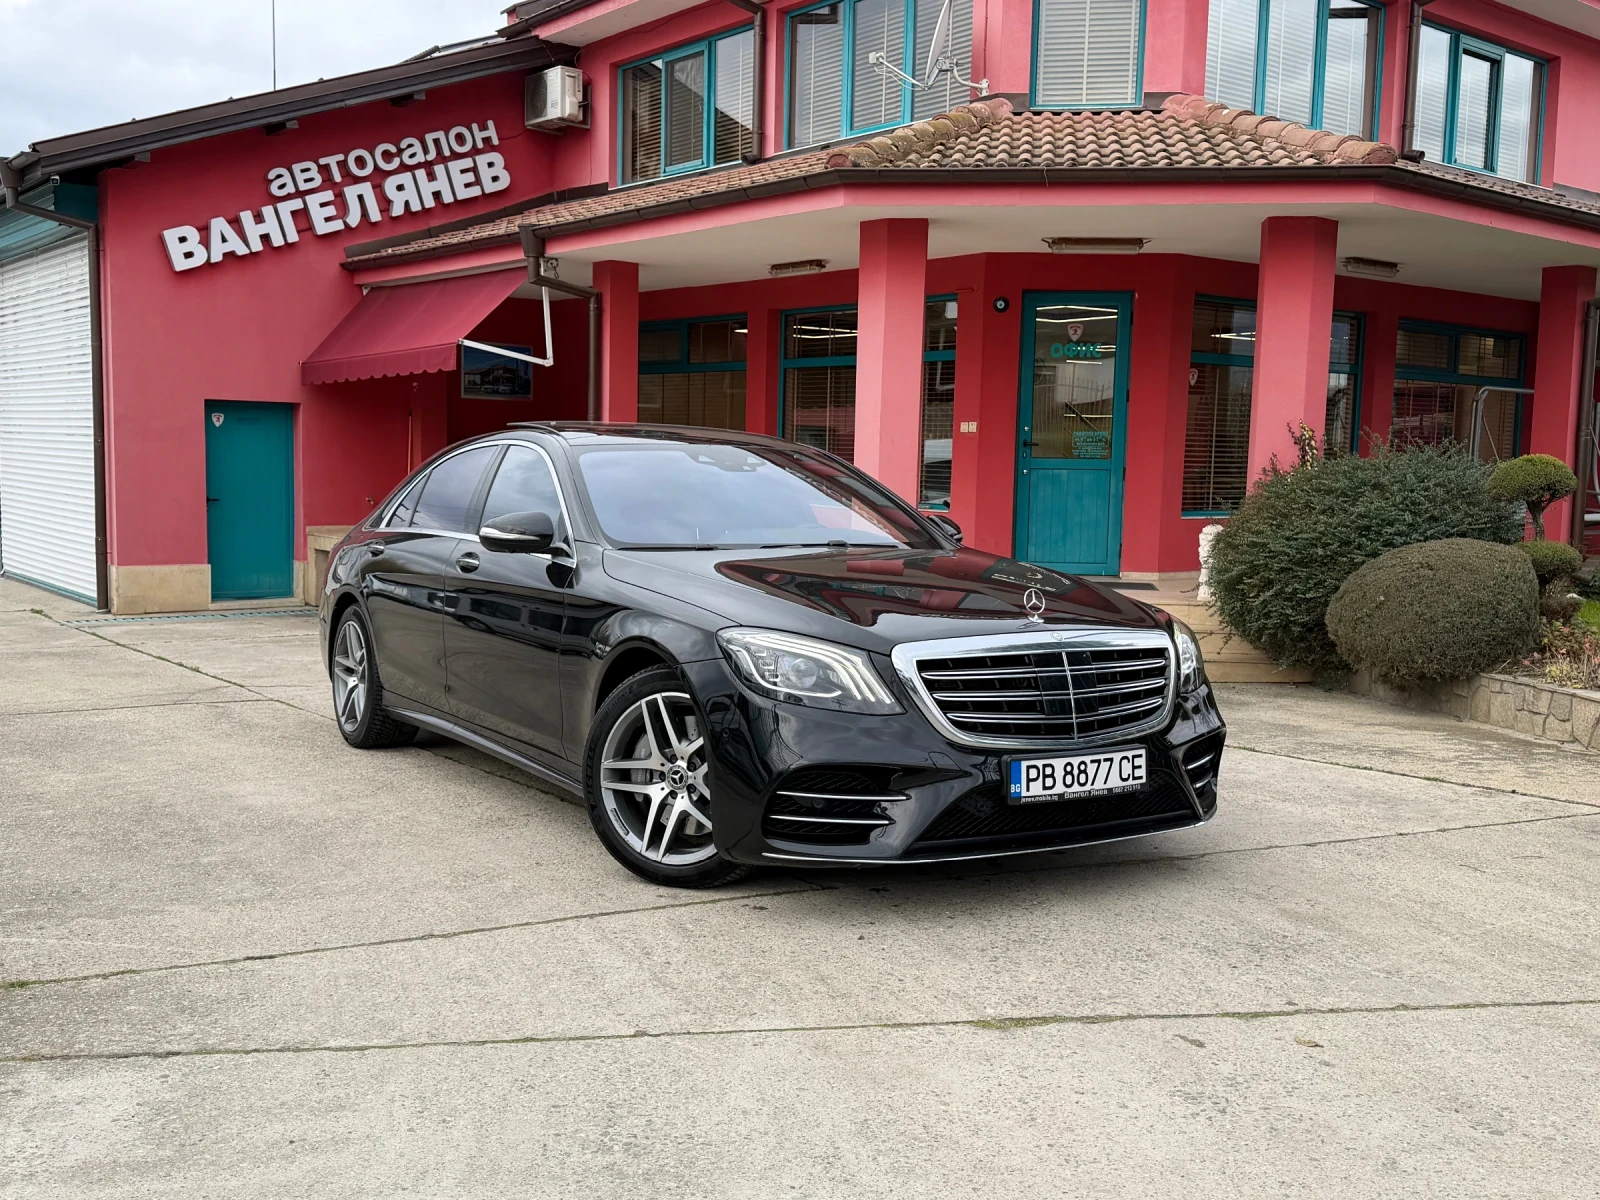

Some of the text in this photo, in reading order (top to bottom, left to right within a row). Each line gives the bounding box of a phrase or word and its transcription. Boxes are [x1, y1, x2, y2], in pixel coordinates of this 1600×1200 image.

[267, 120, 499, 197] автосалон
[162, 152, 511, 272] ВАНГЕЛ ЯНЕВ
[1051, 342, 1101, 358] ОФИС
[1026, 754, 1143, 792] PB 8877 CE
[1011, 784, 1021, 793] BG
[1090, 789, 1108, 797] Янев
